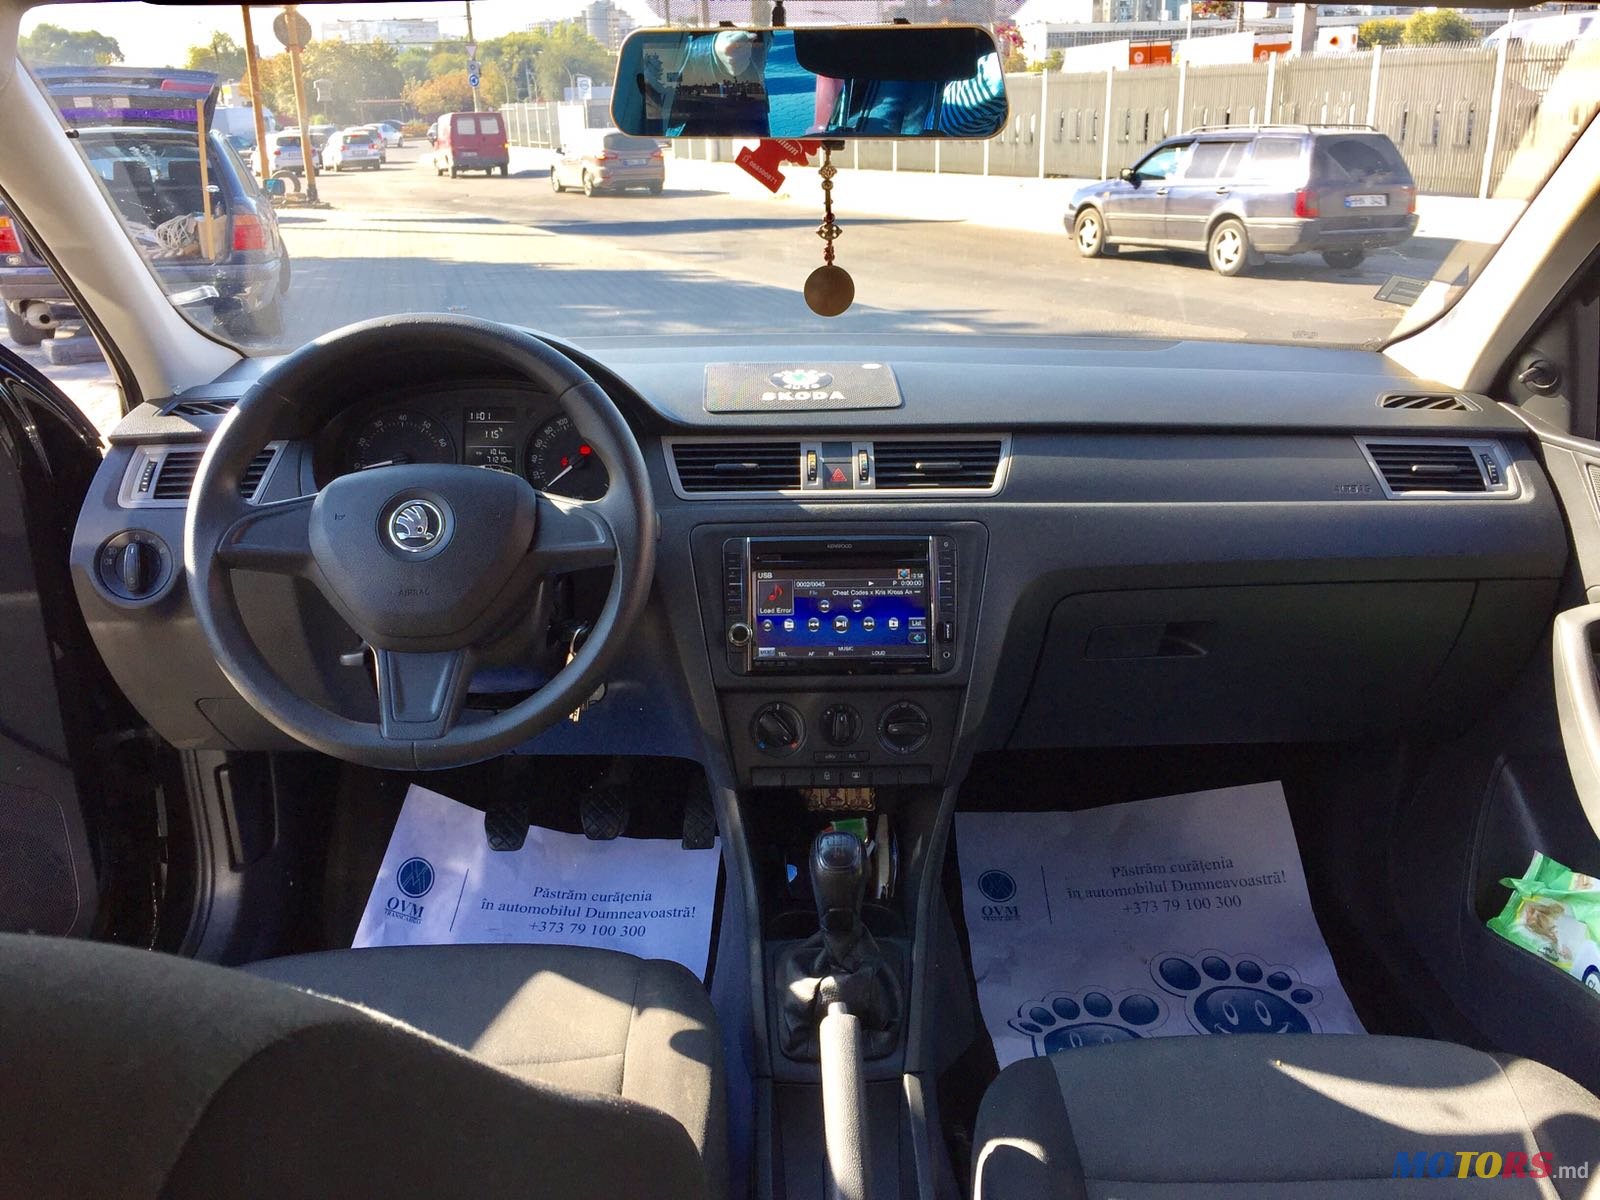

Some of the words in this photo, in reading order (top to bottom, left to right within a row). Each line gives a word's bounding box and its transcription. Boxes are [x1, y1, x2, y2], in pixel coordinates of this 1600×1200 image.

[757, 571, 773, 579] USB
[1111, 863, 1166, 878] Păstrăm
[1066, 887, 1081, 899] în
[1085, 880, 1167, 898] automobilul
[1171, 870, 1287, 893] Dumneavoastră!
[533, 886, 587, 901] Păstrăm
[387, 896, 424, 918] OVM
[480, 897, 494, 910] în
[498, 903, 581, 917] automobilul
[585, 906, 696, 920] Dumneavoastră!
[982, 905, 1018, 916] OVM
[1122, 900, 1159, 914] +373
[1162, 899, 1180, 913] 79
[1186, 897, 1211, 911] 100
[1215, 895, 1242, 909] 300
[529, 921, 564, 933] +373
[569, 923, 587, 935] 79
[592, 924, 617, 937] 100
[620, 925, 646, 937] 300
